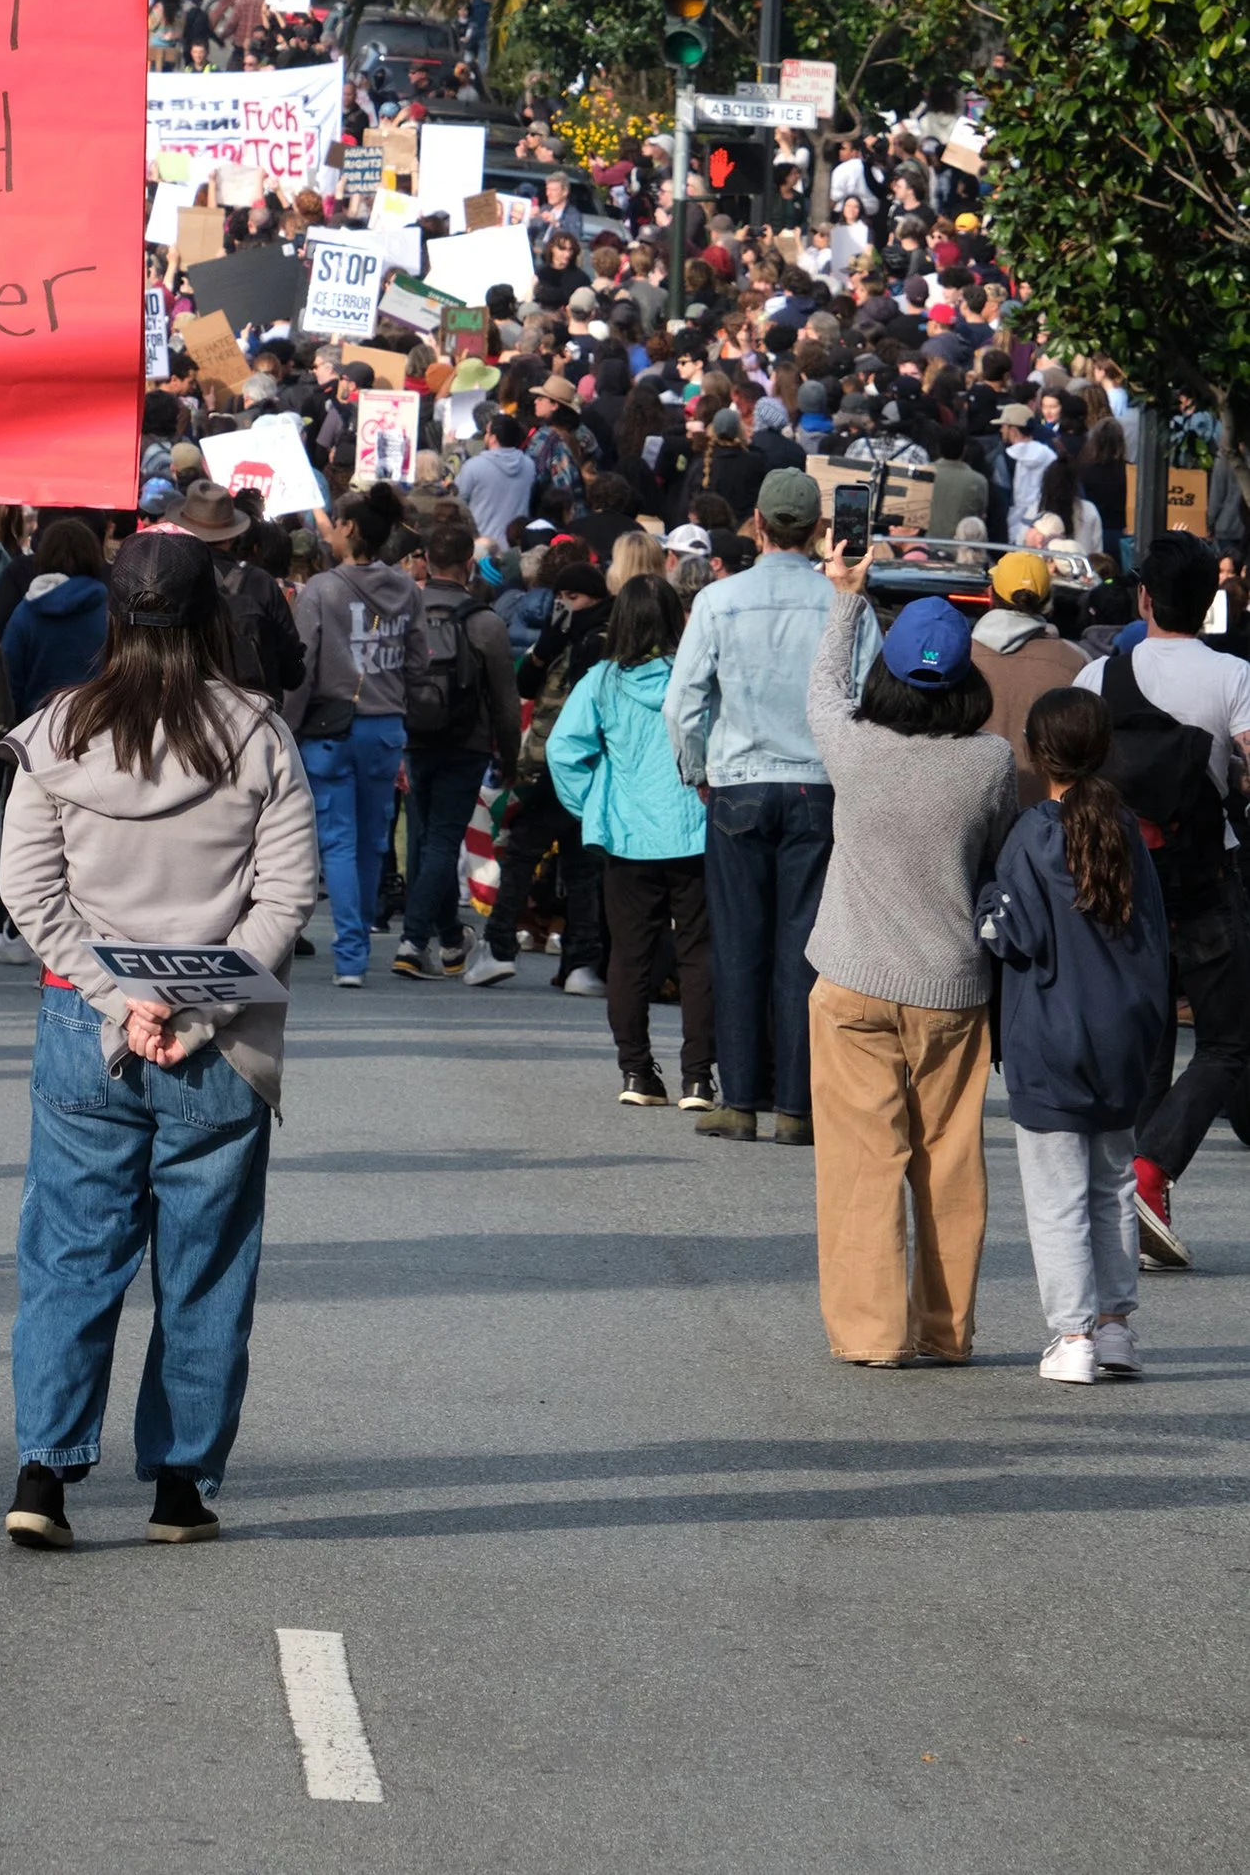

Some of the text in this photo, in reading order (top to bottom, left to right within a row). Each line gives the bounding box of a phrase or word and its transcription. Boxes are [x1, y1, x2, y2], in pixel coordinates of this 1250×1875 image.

[244, 101, 298, 132] FUCK
[711, 103, 804, 121] ABOLISH ICE
[344, 147, 381, 158] HUMAN
[344, 159, 382, 169] RIGHTS
[363, 171, 381, 181] ALL
[318, 250, 377, 286] STOP
[313, 291, 371, 310] ICE TERROR
[311, 307, 369, 322] NOW!
[111, 953, 240, 975] FUCK
[152, 983, 251, 1005] ICE
